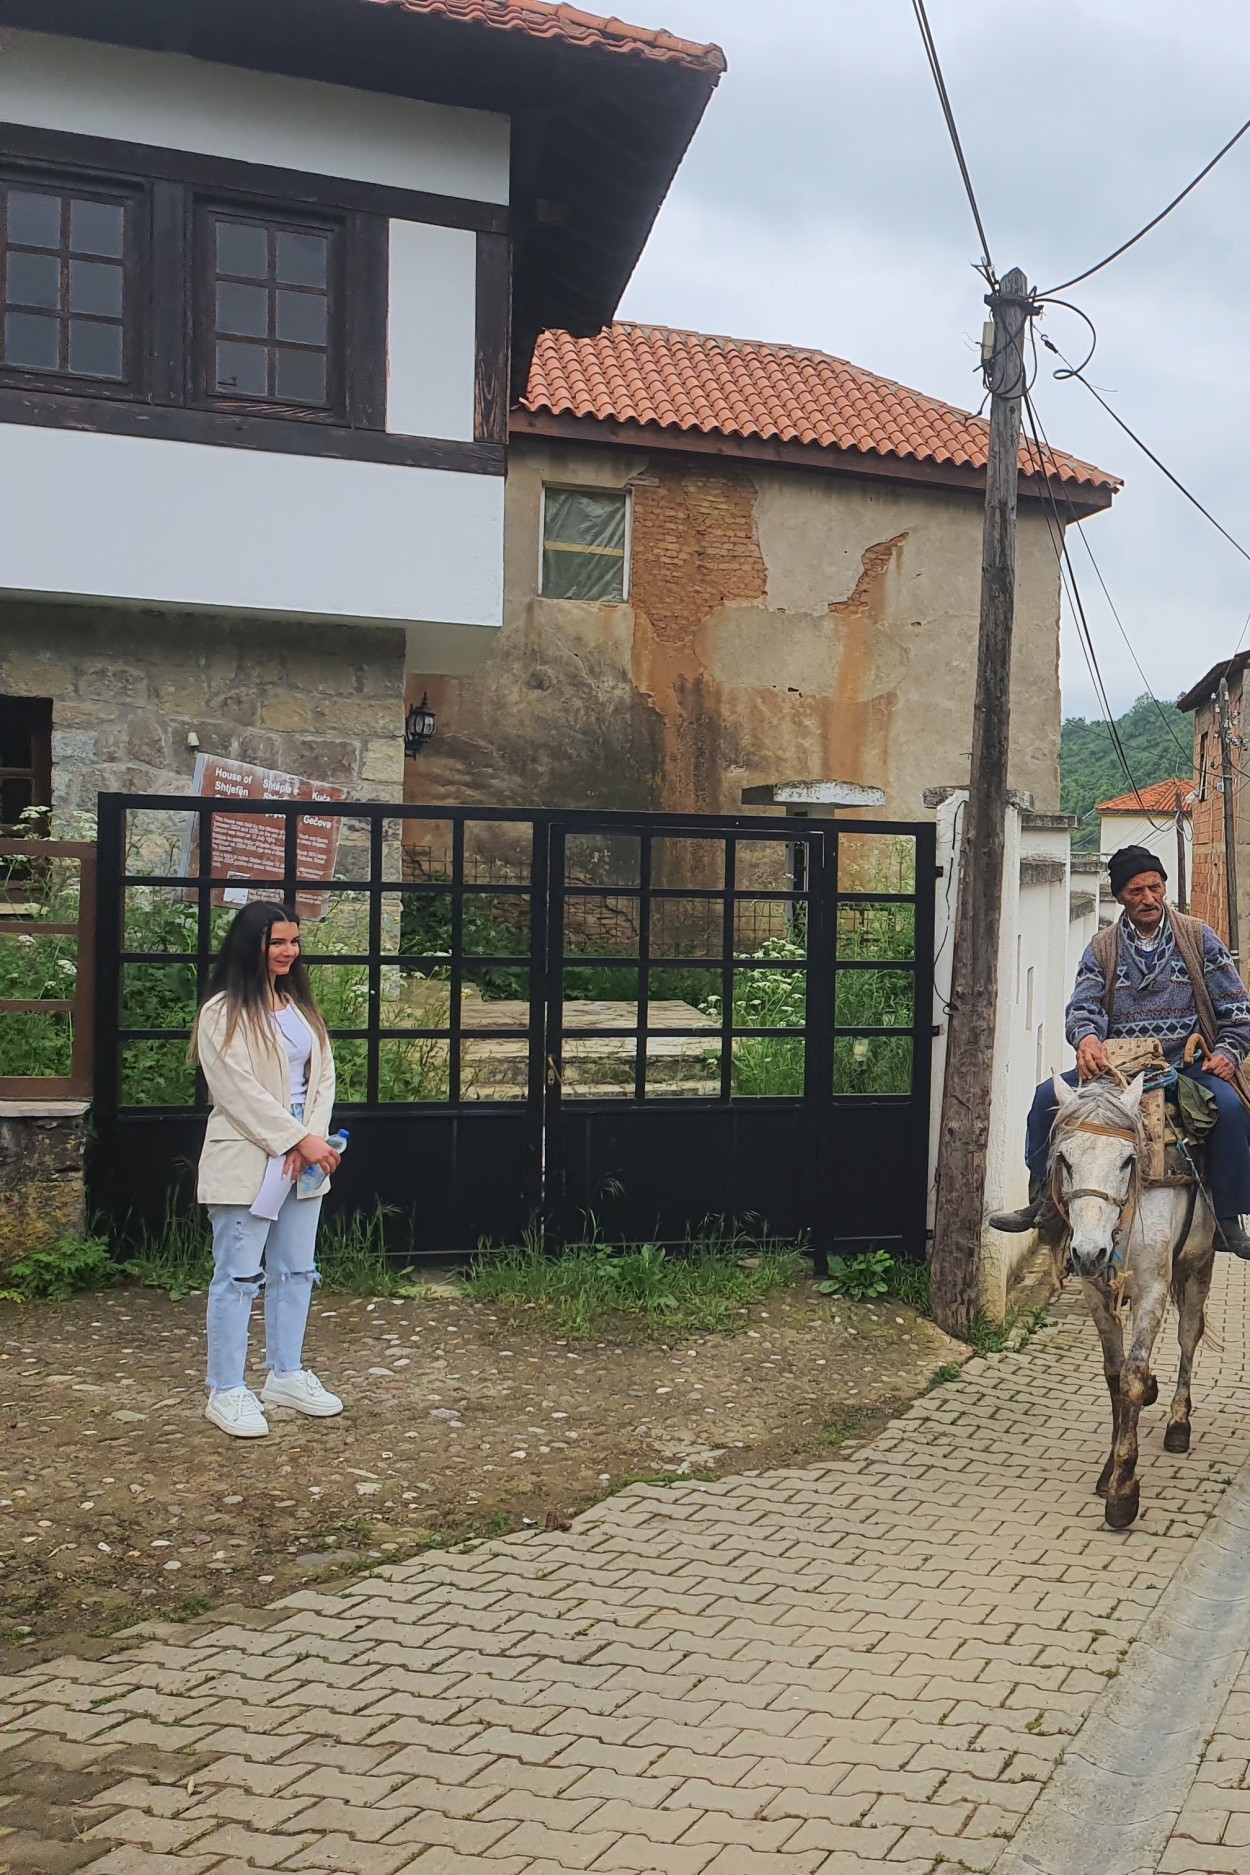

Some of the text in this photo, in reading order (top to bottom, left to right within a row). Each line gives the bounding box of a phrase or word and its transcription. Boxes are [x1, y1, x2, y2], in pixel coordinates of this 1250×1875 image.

[215, 767, 253, 785] House of
[215, 781, 249, 798] Shtjefën
[303, 814, 332, 829] Gečova
